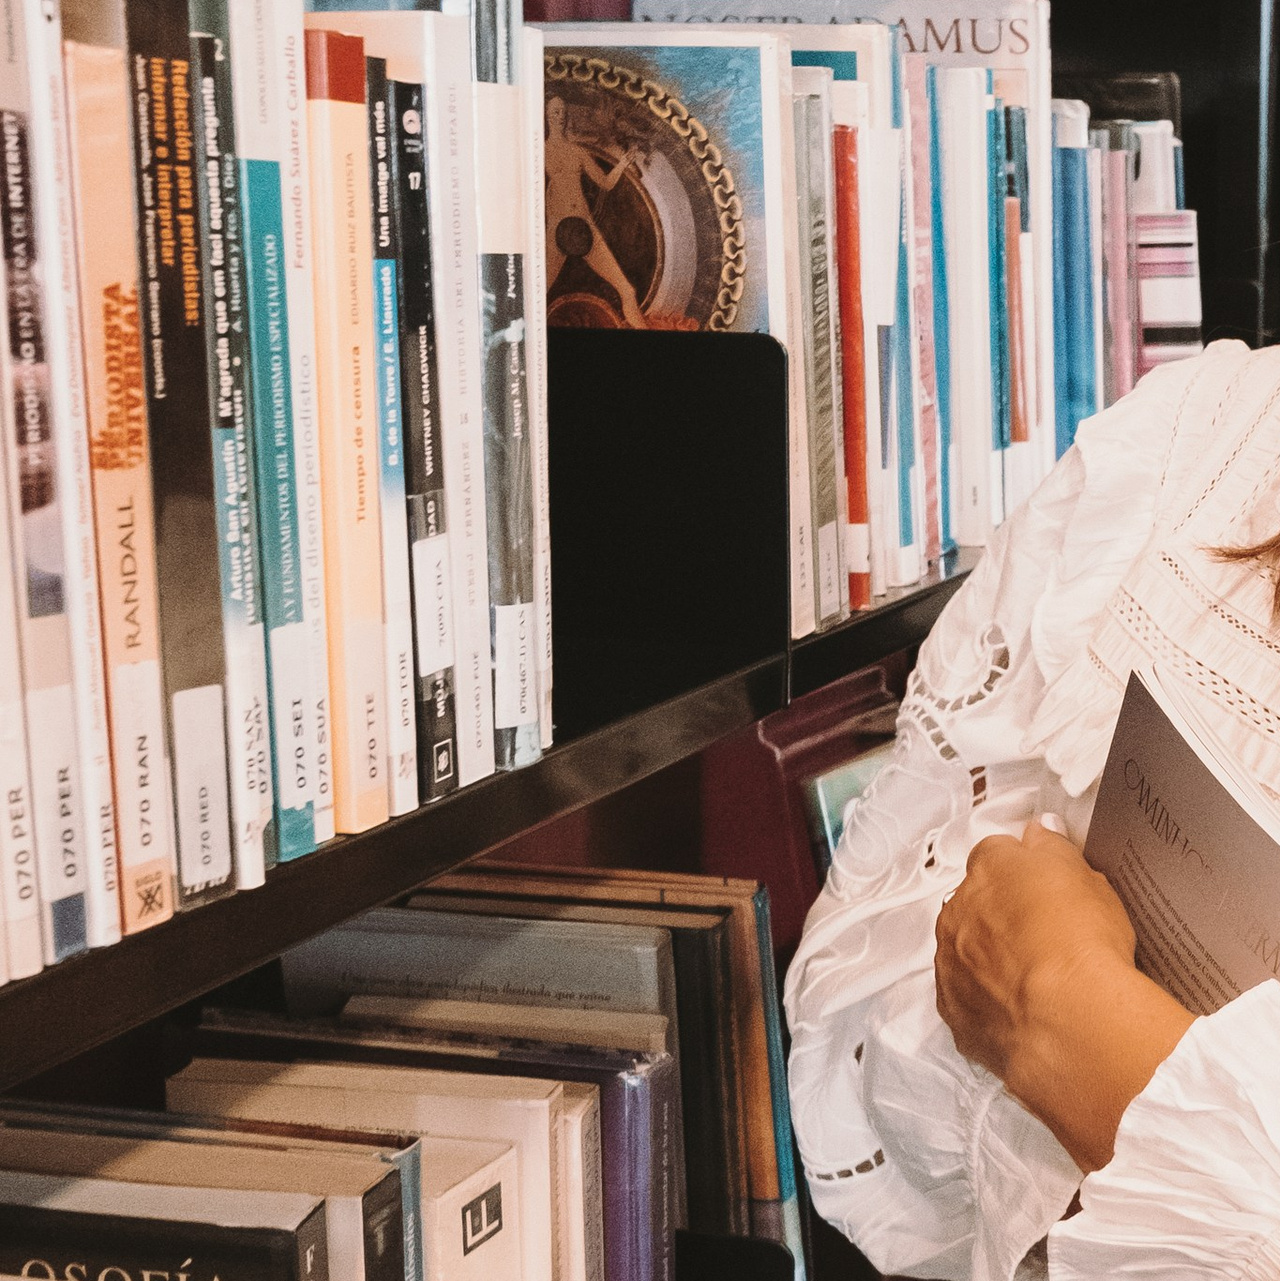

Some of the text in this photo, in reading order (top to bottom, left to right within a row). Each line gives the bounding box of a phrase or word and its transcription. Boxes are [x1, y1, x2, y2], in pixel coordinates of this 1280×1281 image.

[5, 114, 26, 208] INTERNET
[141, 172, 155, 208] José
[155, 145, 170, 160] e
[170, 59, 201, 326] Redacción para periodistas:
[285, 35, 305, 271] Fernando Suárez Carballo
[345, 151, 356, 219] BAUTISTA
[374, 100, 391, 248] Una val més
[156, 163, 176, 267] interpretar
[201, 76, 234, 419] M'agrada que em faci aquesta pregunta
[348, 259, 360, 325] EDUARDO
[102, 282, 125, 470] PERIODISTA
[119, 286, 145, 468] UNIVERSAL
[264, 233, 295, 595] FUNDAMENTOS DEL PERIODISMO ESPECIALIZADO
[383, 364, 397, 410] Torre
[385, 412, 397, 427] la
[418, 324, 436, 478] WHITNEY CHADWICK
[512, 400, 524, 440] Josep
[298, 353, 321, 613] del diseño periodístico
[350, 345, 368, 525] Tiempo de censura
[386, 428, 398, 451] de
[222, 438, 247, 602] Arturo San Agustín
[117, 495, 143, 651] RANDALL
[364, 692, 379, 780] 070 TIE
[398, 651, 411, 728] 070 TOR
[136, 734, 152, 847] 070 RAN
[257, 750, 269, 795] 070
[291, 698, 308, 789] 070 SEI
[316, 697, 330, 795] 070 SUA
[8, 786, 33, 901] 070 PER
[56, 765, 76, 879] 070 PER
[100, 802, 116, 892] 070 PER
[198, 786, 212, 866] 070 RED
[1181, 922, 1198, 940] dores
